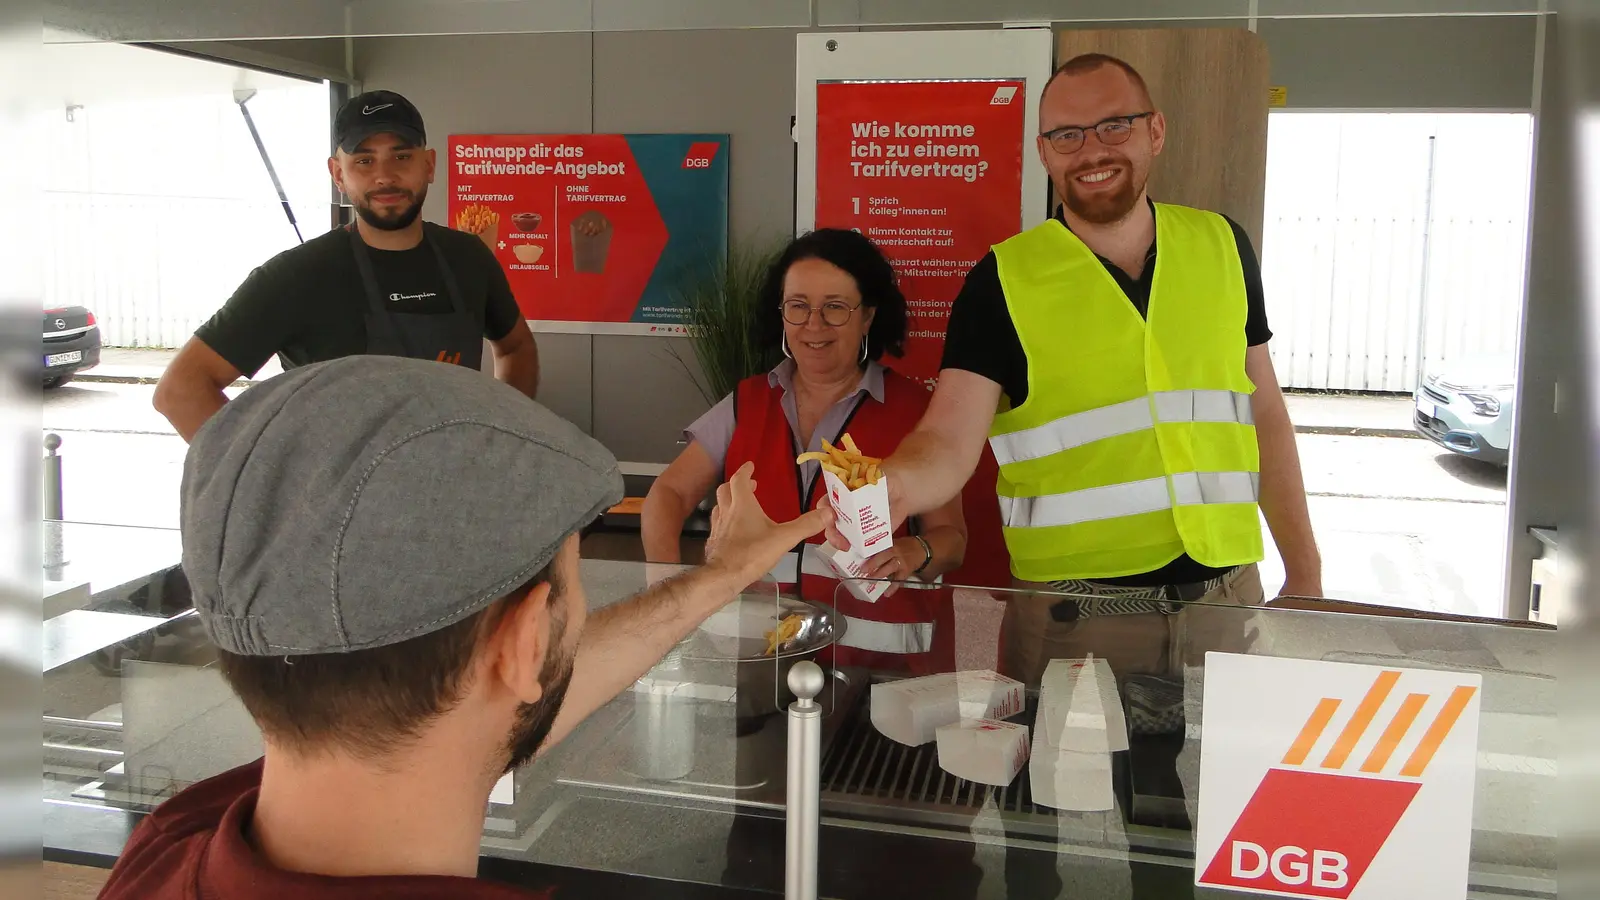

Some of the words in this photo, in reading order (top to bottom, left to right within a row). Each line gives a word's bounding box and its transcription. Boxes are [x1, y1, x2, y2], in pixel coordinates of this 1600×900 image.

[851, 120, 890, 138] Wie
[894, 121, 975, 138] komme
[455, 144, 526, 163] Schnapp
[528, 143, 552, 158] dir
[553, 144, 584, 158] das
[850, 140, 882, 158] ich
[886, 144, 910, 158] zu
[913, 140, 980, 158] einem
[686, 158, 709, 168] DGB
[455, 160, 625, 180] Tarifwende-Angebot
[850, 160, 989, 183] Tarifvertrag?
[457, 185, 473, 193] MIT
[566, 185, 590, 193] OHNE
[457, 194, 515, 202] TARIFVERTRAG
[566, 194, 627, 203] TARIFVERTRAG
[868, 196, 899, 206] Sprich
[851, 197, 860, 215] 1
[930, 207, 947, 216] an!
[868, 227, 897, 236] Nimm
[898, 227, 937, 236] Kontakt
[937, 228, 953, 236] zur
[934, 238, 954, 247] auf!
[509, 263, 550, 271] URLAUBSGELD
[921, 258, 957, 267] wählen
[958, 259, 978, 268] und
[389, 291, 437, 301] Champion
[906, 298, 946, 308] mission
[917, 309, 927, 318] in
[928, 309, 945, 318] der
[908, 329, 947, 341] andlung
[858, 504, 872, 513] Mehr
[1230, 839, 1350, 890] DGB
